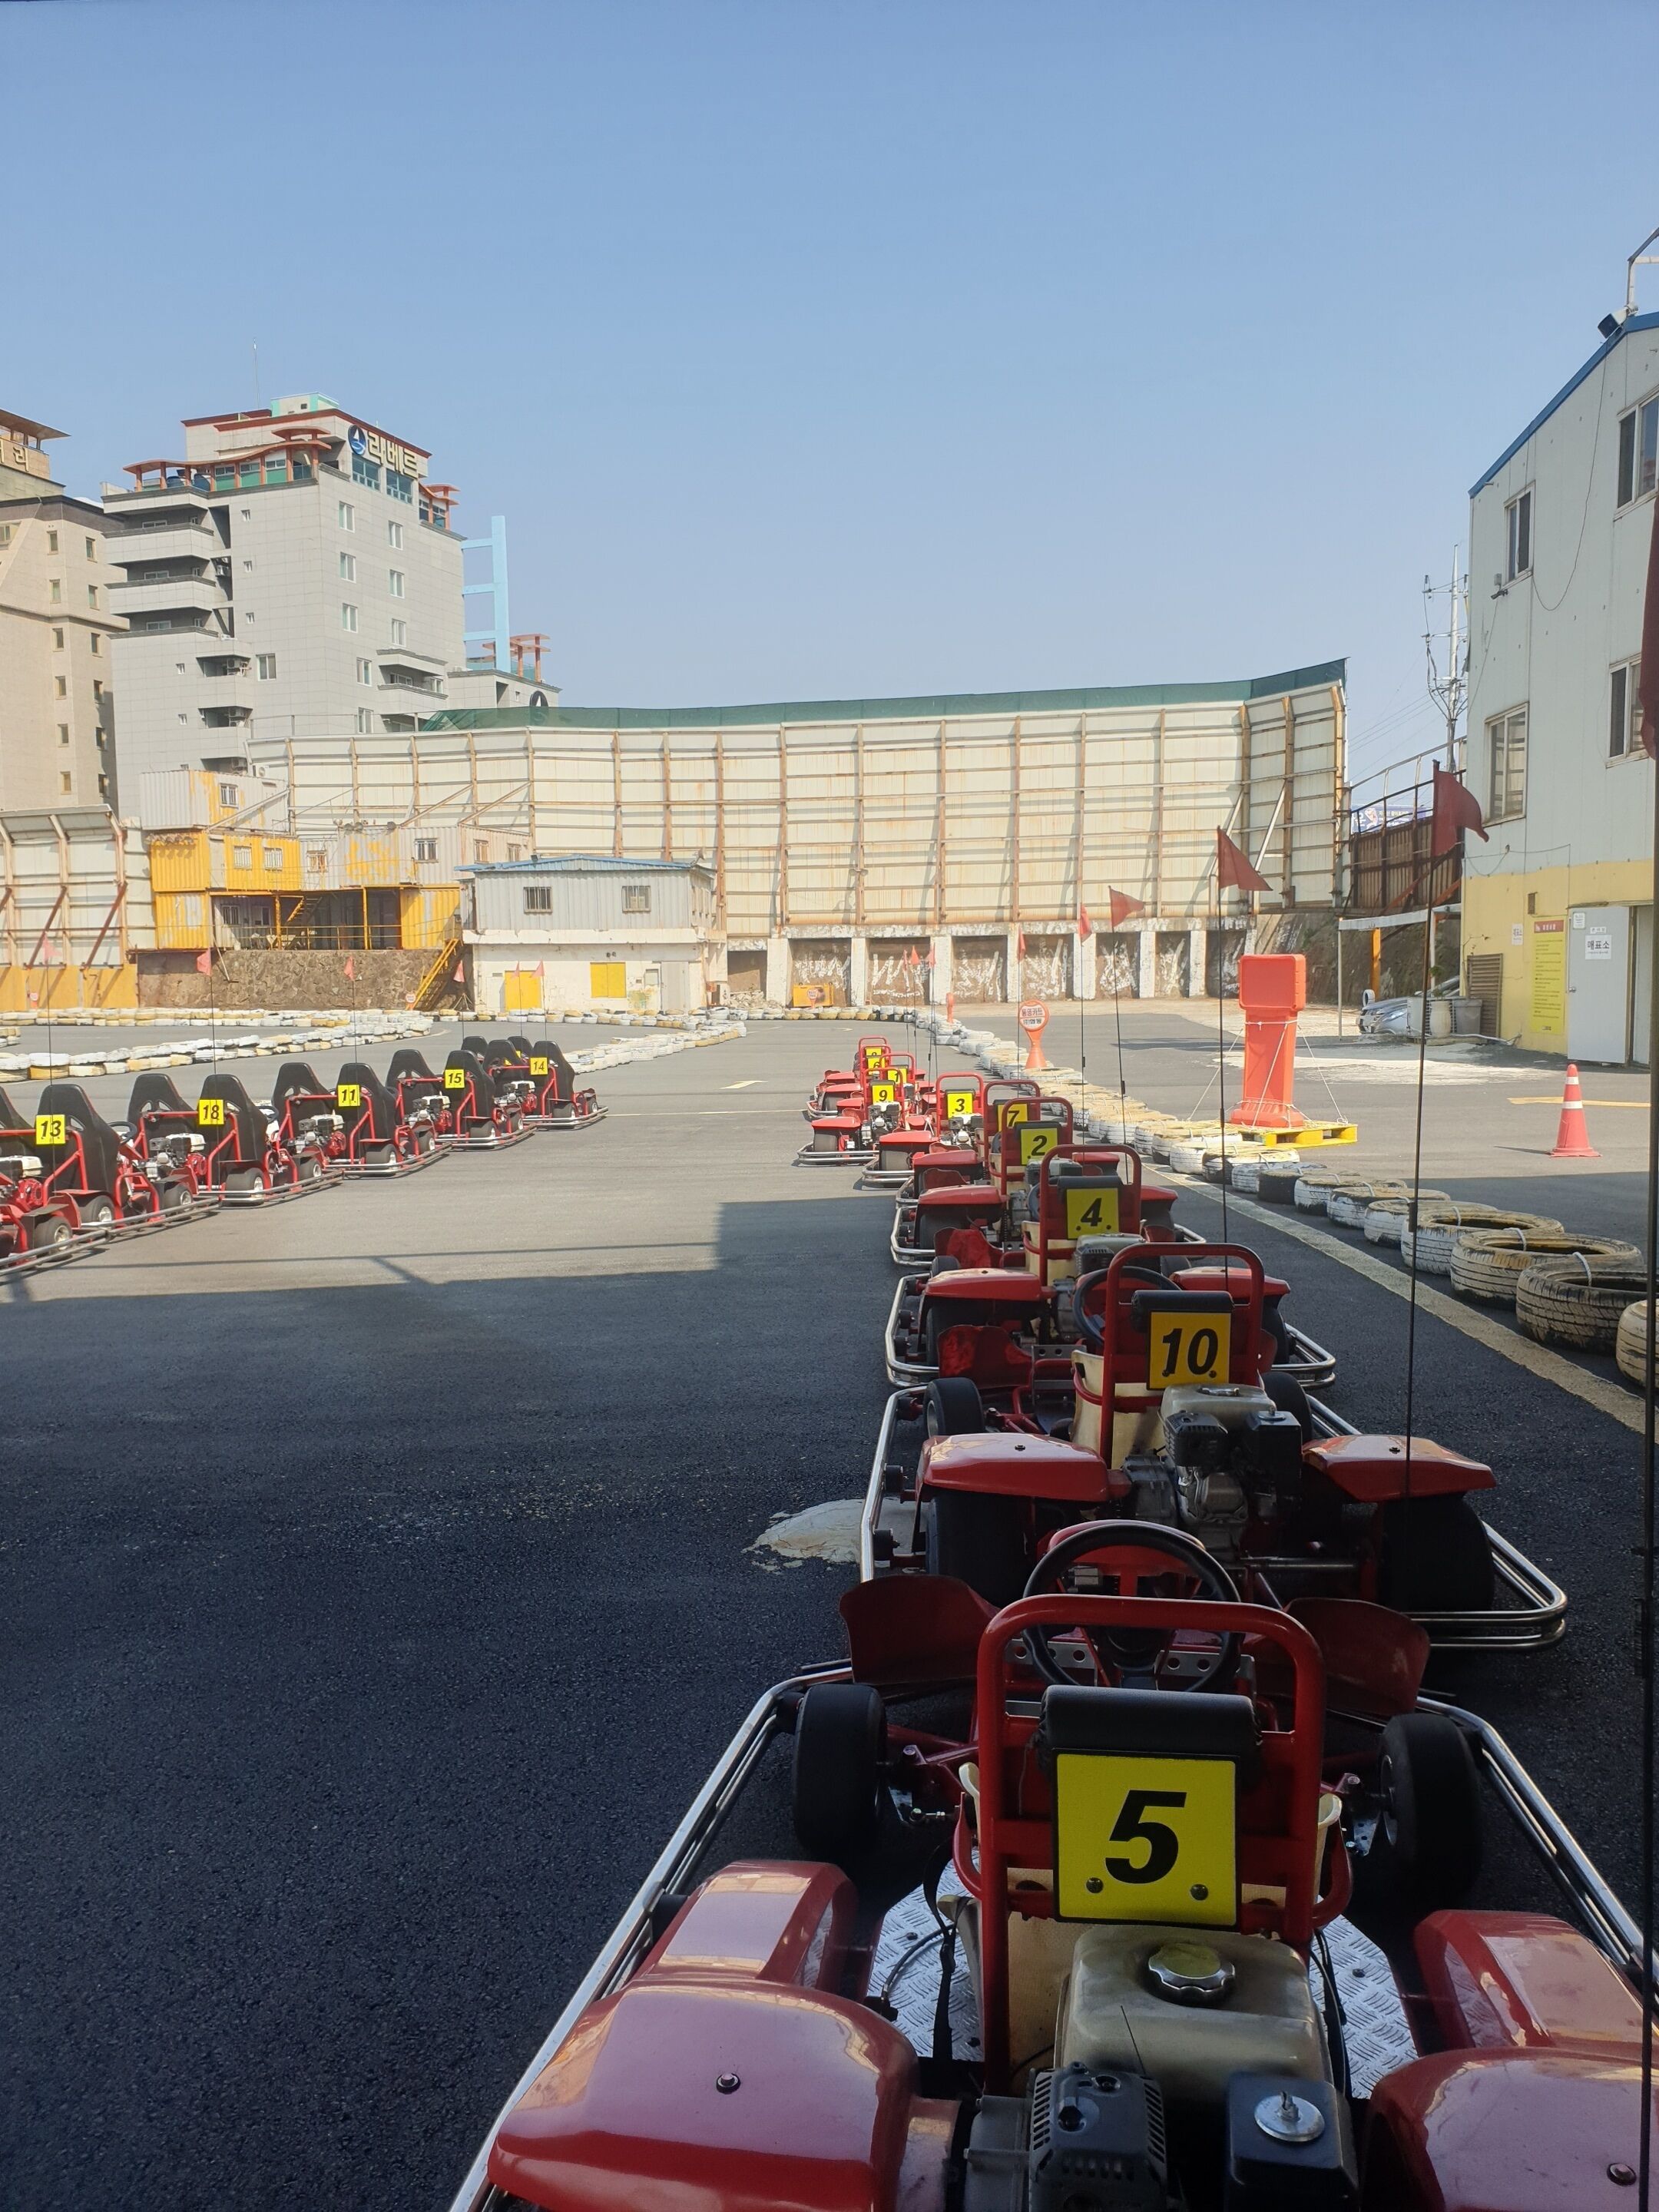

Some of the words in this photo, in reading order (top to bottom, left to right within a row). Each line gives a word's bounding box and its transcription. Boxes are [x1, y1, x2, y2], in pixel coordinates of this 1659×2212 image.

[0, 439, 29, 472] 리
[367, 430, 419, 480] 라베르
[1587, 939, 1611, 951] 매표소
[533, 1061, 545, 1071] 14
[448, 1072, 462, 1084] 15
[341, 1088, 356, 1101] 11
[879, 1090, 888, 1102] 9
[203, 1104, 220, 1120] 18
[955, 1098, 965, 1112] 3
[1008, 1110, 1020, 1128] 7
[41, 1120, 61, 1137] 13
[1031, 1134, 1048, 1156] 2
[1080, 1197, 1103, 1227] 4
[1161, 1327, 1219, 1377] 10
[1104, 1790, 1187, 1884] 5
